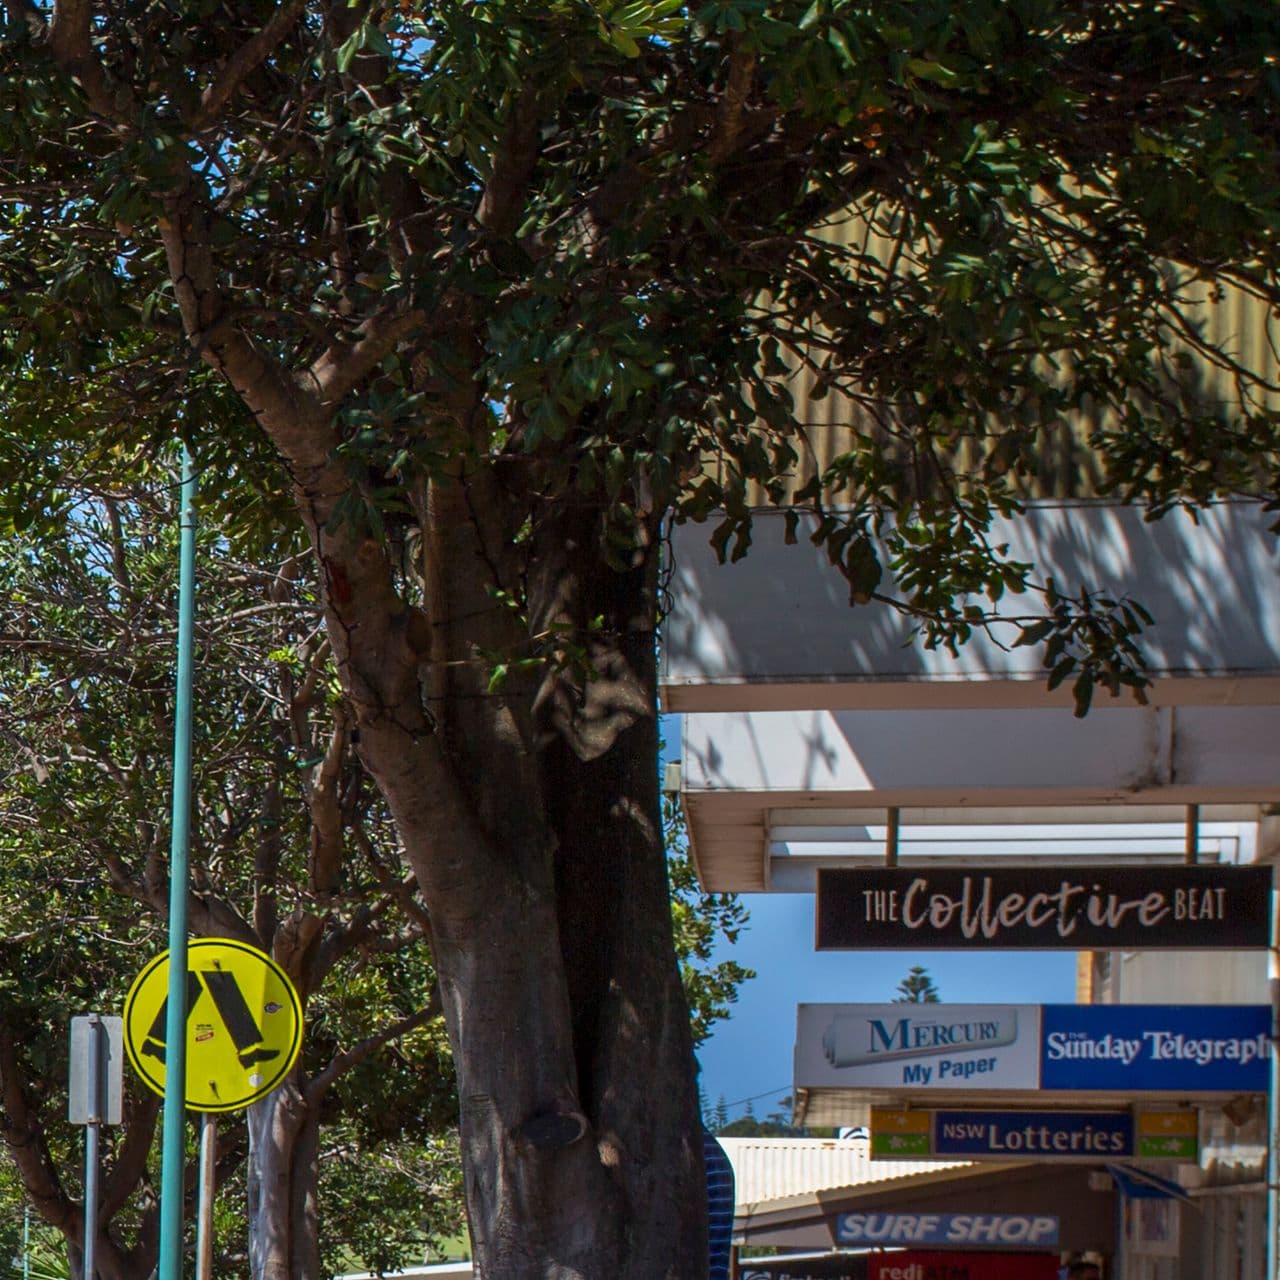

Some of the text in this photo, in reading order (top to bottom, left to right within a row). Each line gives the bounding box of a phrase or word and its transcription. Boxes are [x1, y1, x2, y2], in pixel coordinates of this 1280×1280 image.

[862, 876, 1227, 939] THE Collective BEAT
[866, 1017, 1000, 1054] MERCURY
[1047, 1031, 1274, 1065] Sunday Telegraph
[902, 1056, 998, 1085] My Paper
[943, 1123, 1125, 1150] NSW Lotteries
[841, 1214, 1056, 1242] SURF SHOP
